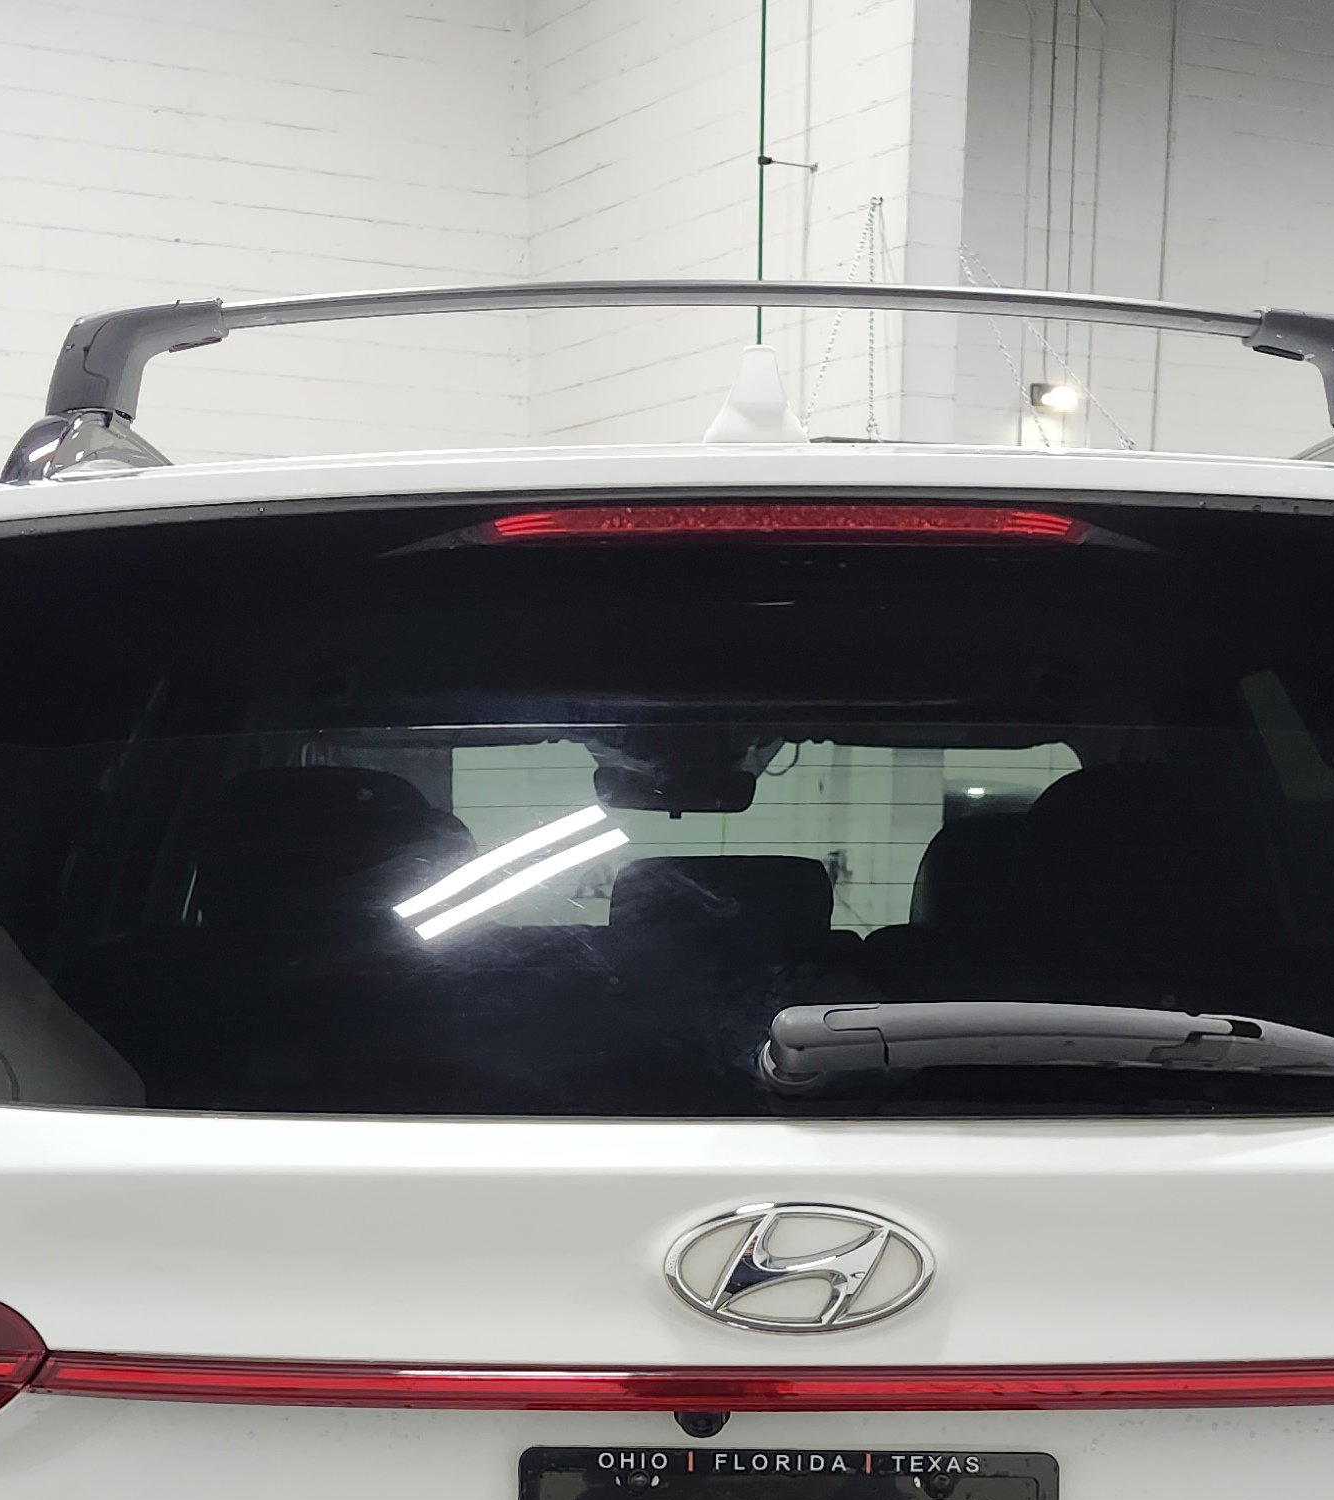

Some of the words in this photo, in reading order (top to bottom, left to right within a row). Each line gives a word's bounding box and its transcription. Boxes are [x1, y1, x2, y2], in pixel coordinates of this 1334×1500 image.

[597, 1452, 668, 1471] OHIO
[714, 1454, 848, 1472] FLORIDA
[891, 1455, 980, 1474] TEXAS
